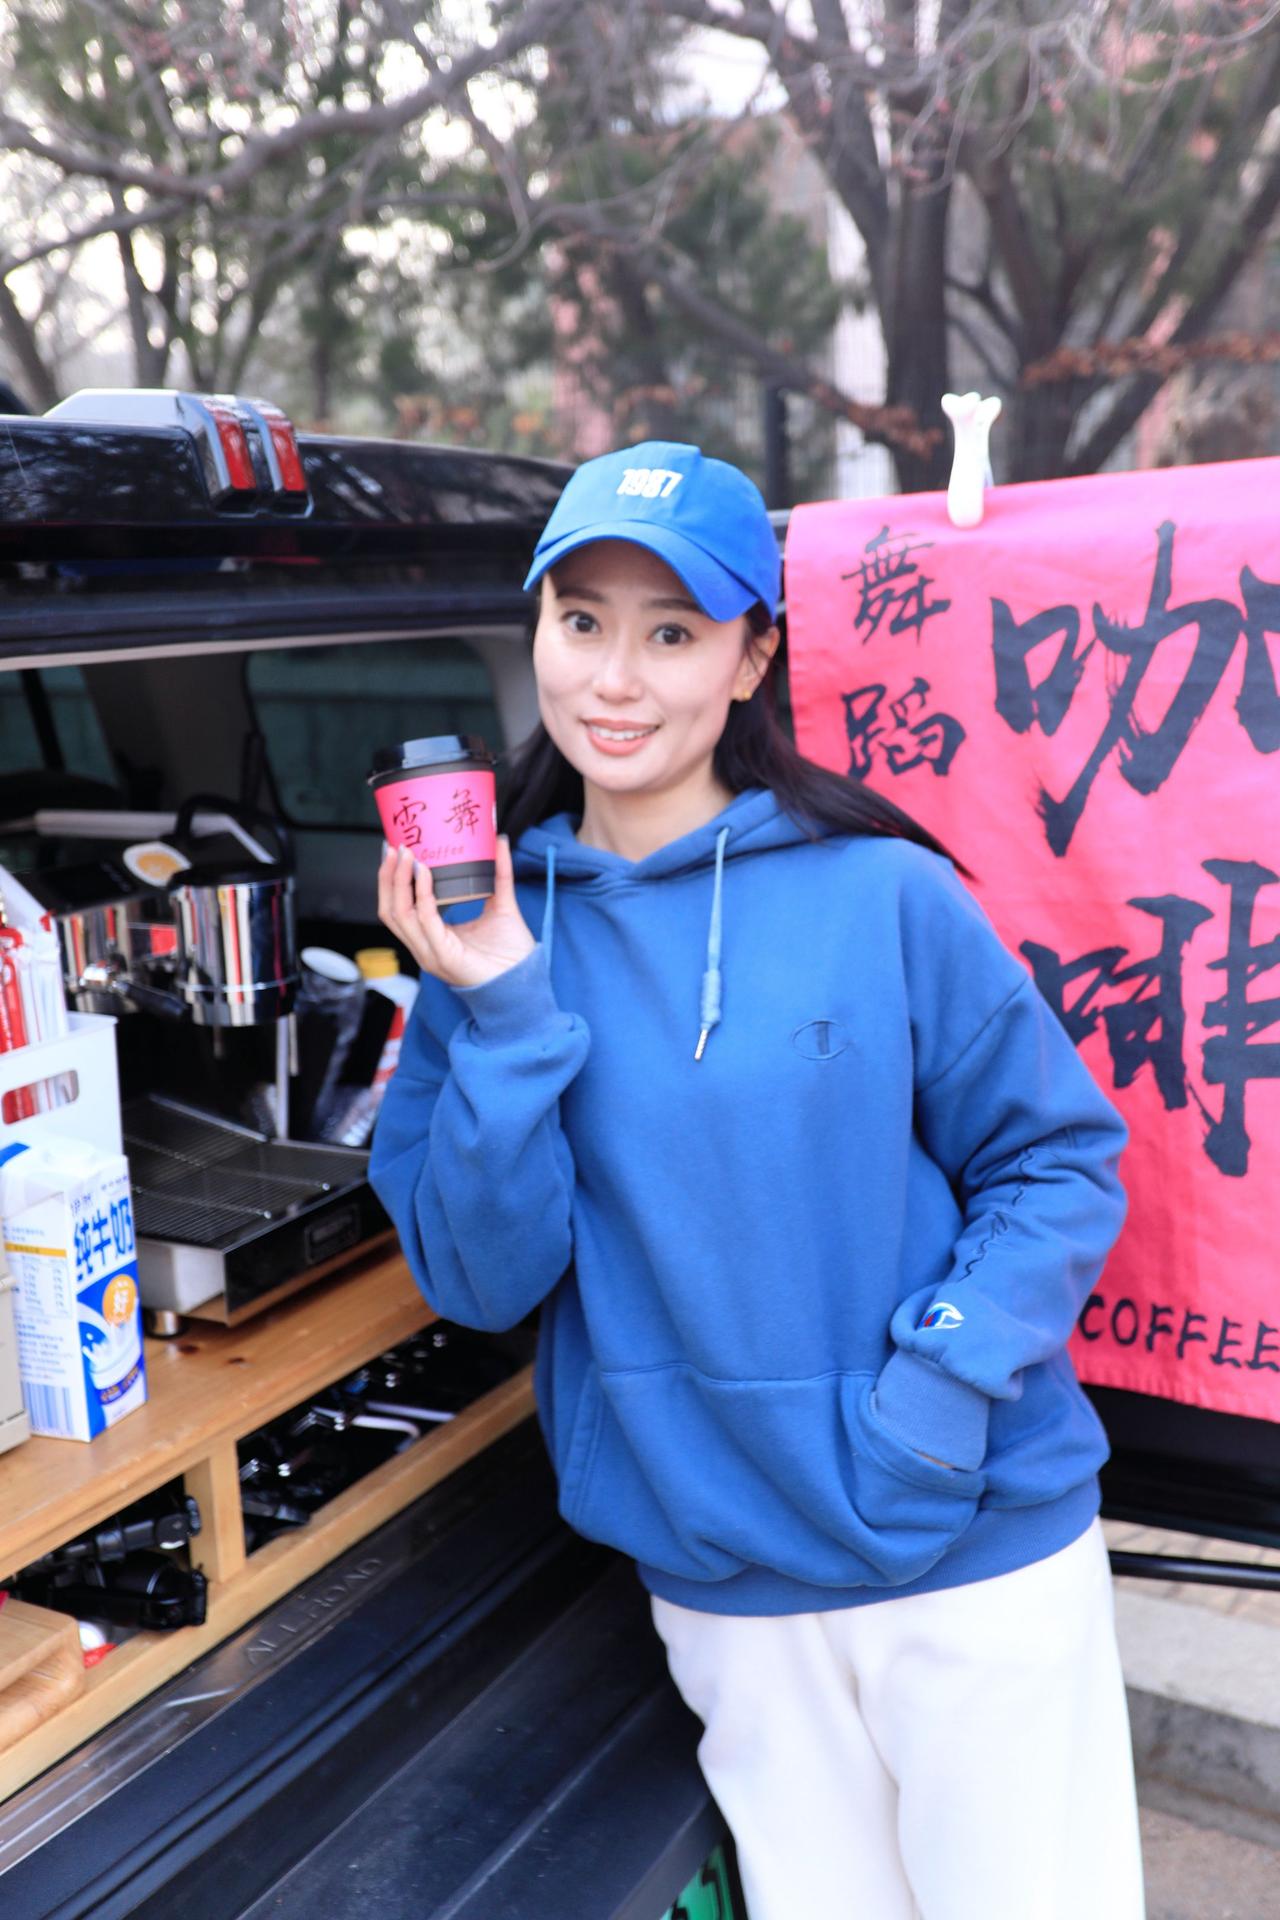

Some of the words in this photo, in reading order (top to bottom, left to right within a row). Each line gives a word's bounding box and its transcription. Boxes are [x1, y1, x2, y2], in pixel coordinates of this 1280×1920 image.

[842, 525, 966, 782] 舞蹈
[75, 1197, 135, 1281] 纯牛奶
[1078, 1292, 1280, 1372] COFFEE
